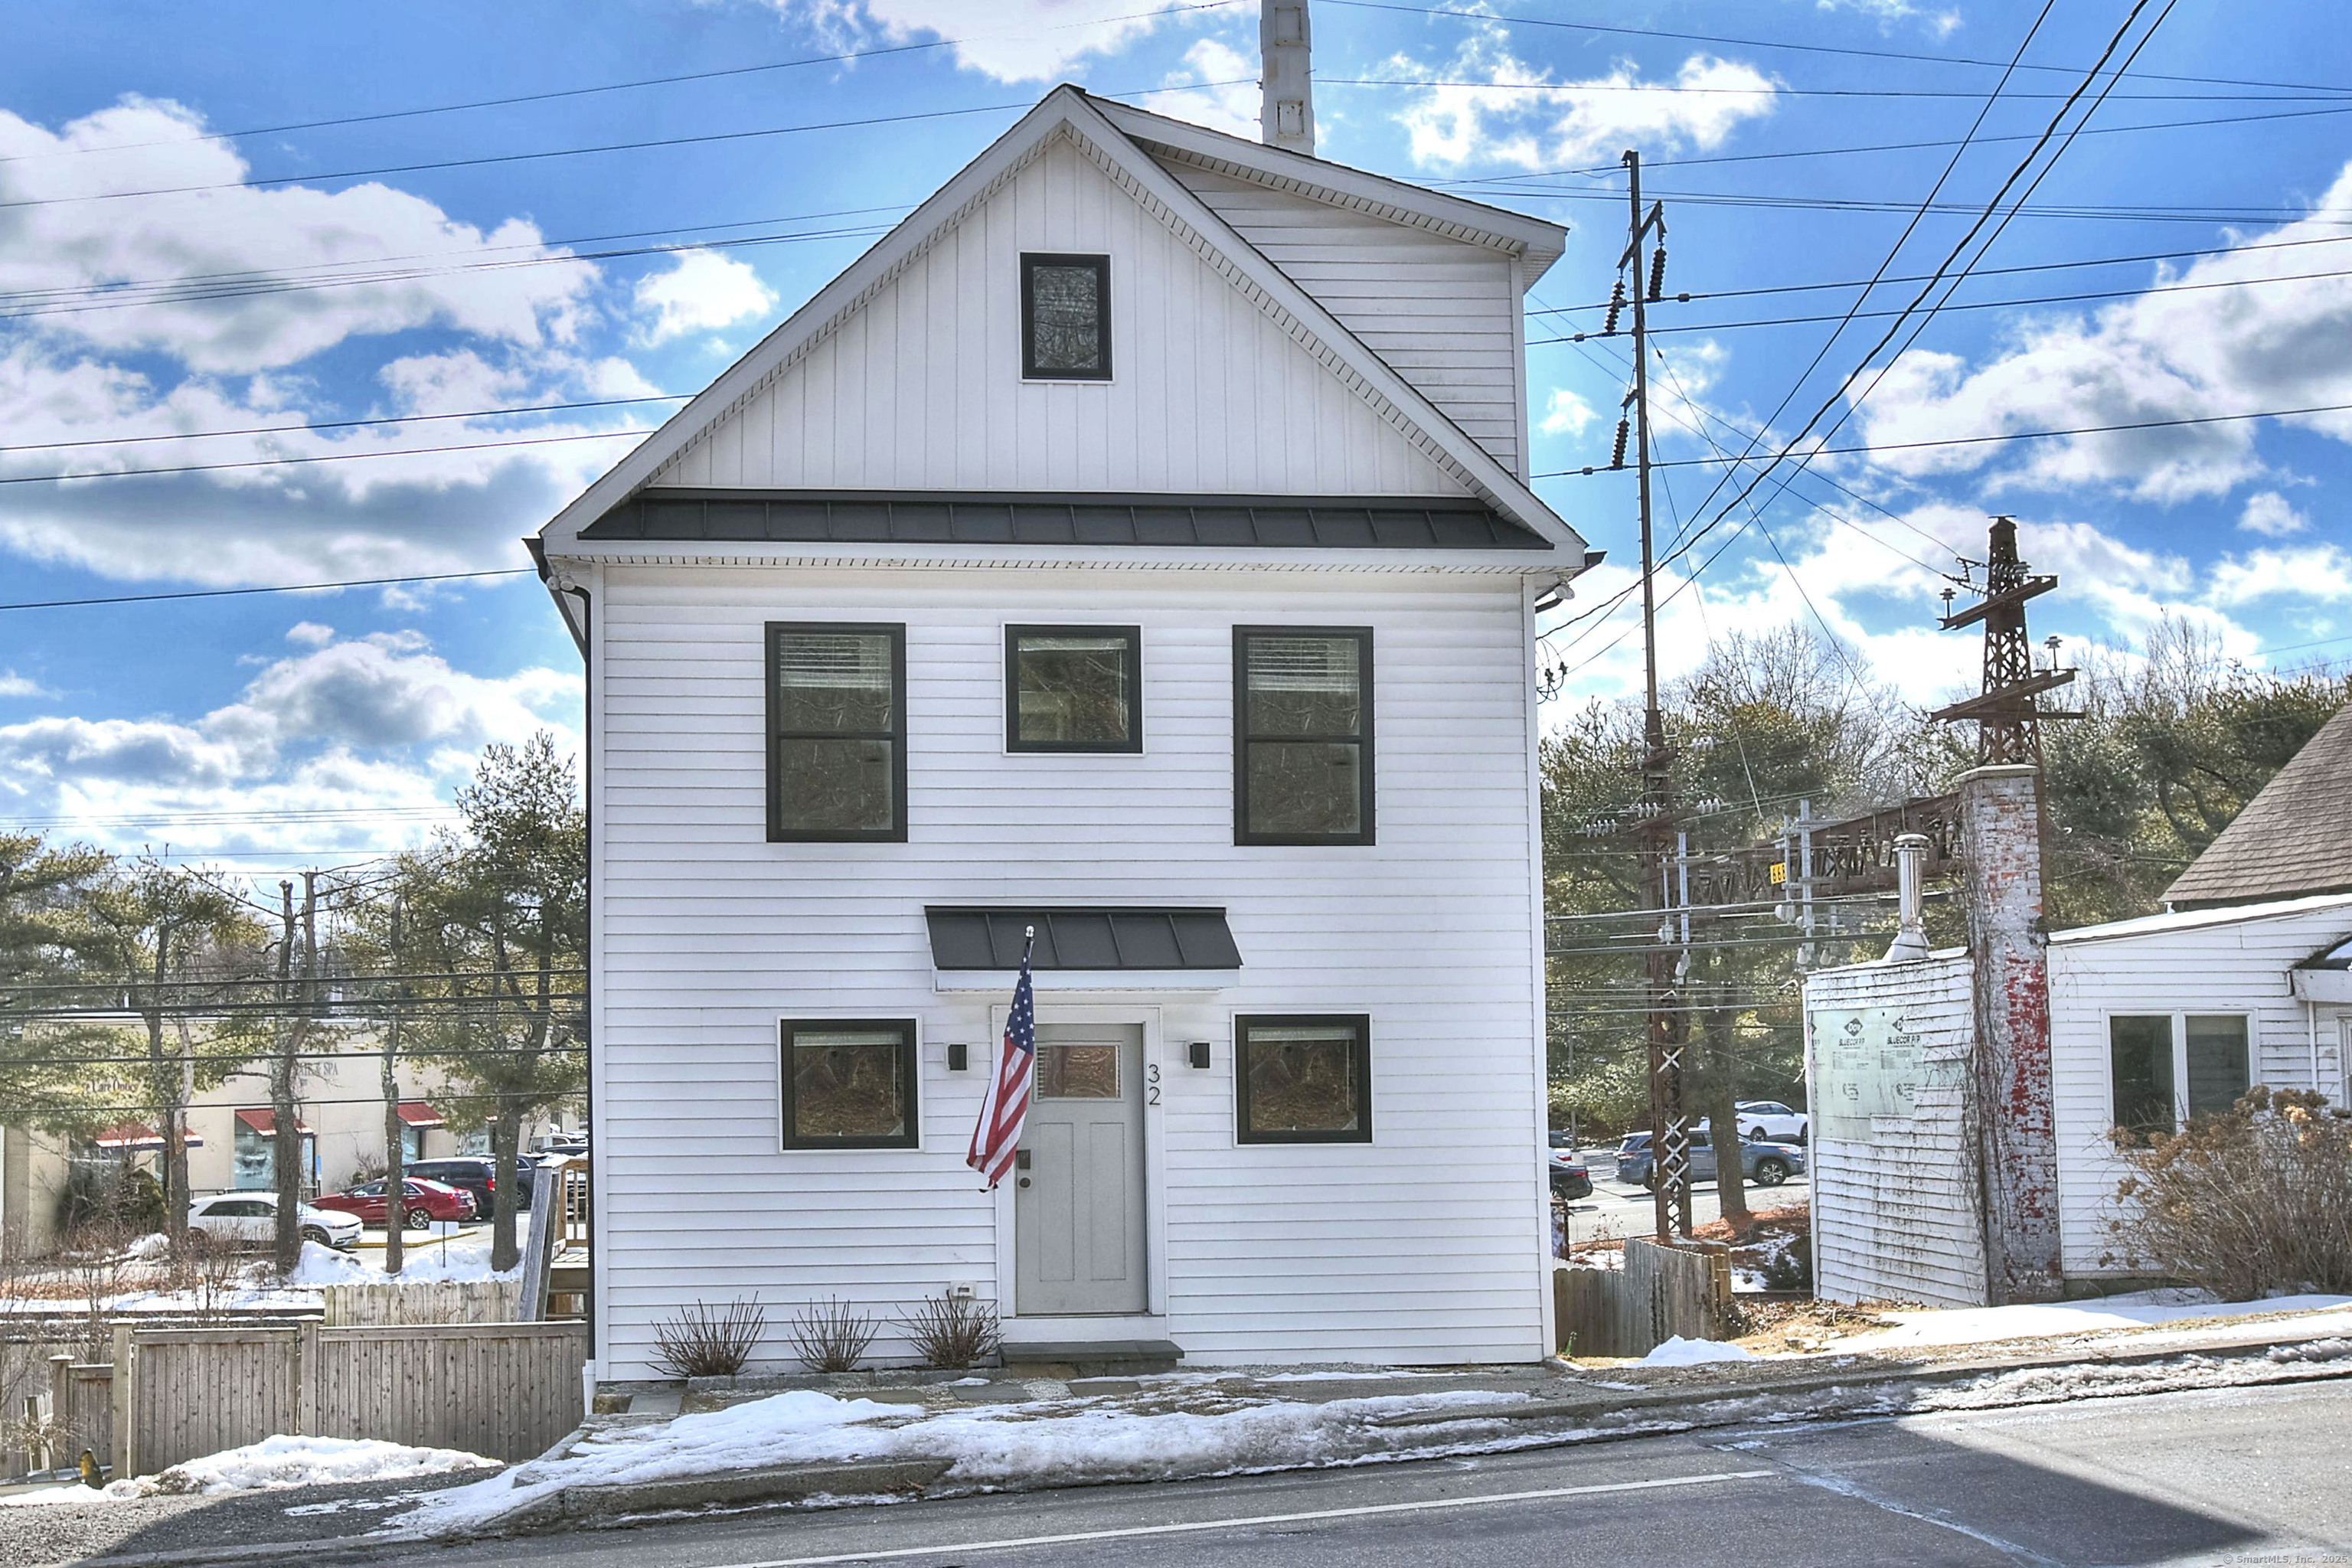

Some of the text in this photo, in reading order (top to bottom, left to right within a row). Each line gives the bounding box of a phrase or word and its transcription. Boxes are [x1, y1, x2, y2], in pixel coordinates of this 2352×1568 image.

[1887, 1036, 1909, 1044] BLUECOR
[323, 1062, 338, 1075] SPA
[1148, 1064, 1160, 1105] 32
